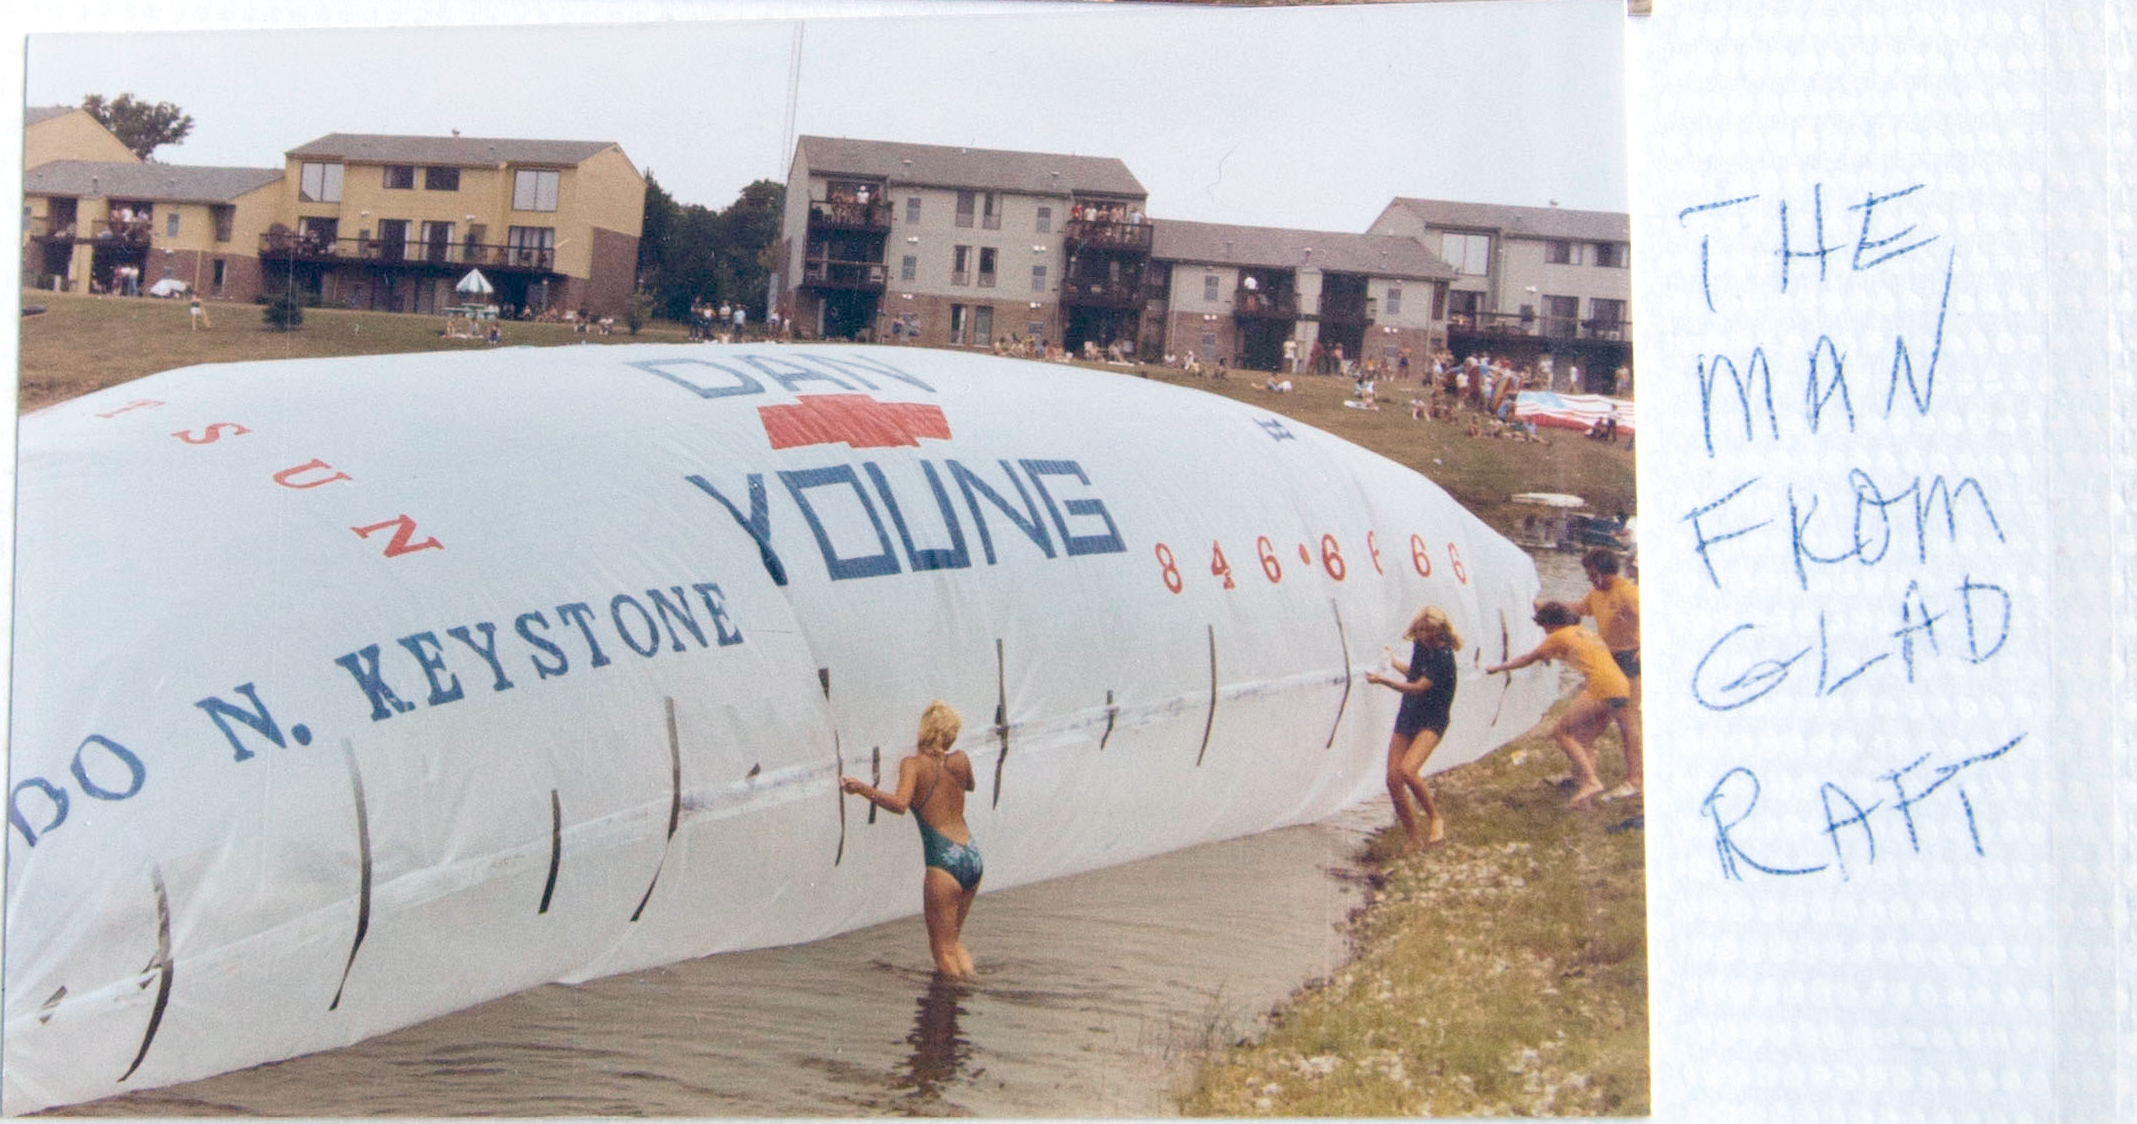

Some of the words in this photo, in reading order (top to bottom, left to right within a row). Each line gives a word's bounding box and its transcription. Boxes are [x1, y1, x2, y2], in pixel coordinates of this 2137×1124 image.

[1680, 182, 1940, 313] THE
[623, 353, 938, 399] DAN
[1698, 245, 1955, 458] MAN
[685, 459, 1127, 586] YOUNG
[1678, 468, 2006, 590] FROM
[195, 683, 312, 762] N.
[334, 583, 744, 722] KEYSTONE
[1692, 574, 2010, 711] GLAD
[1701, 732, 2029, 881] RAFT
